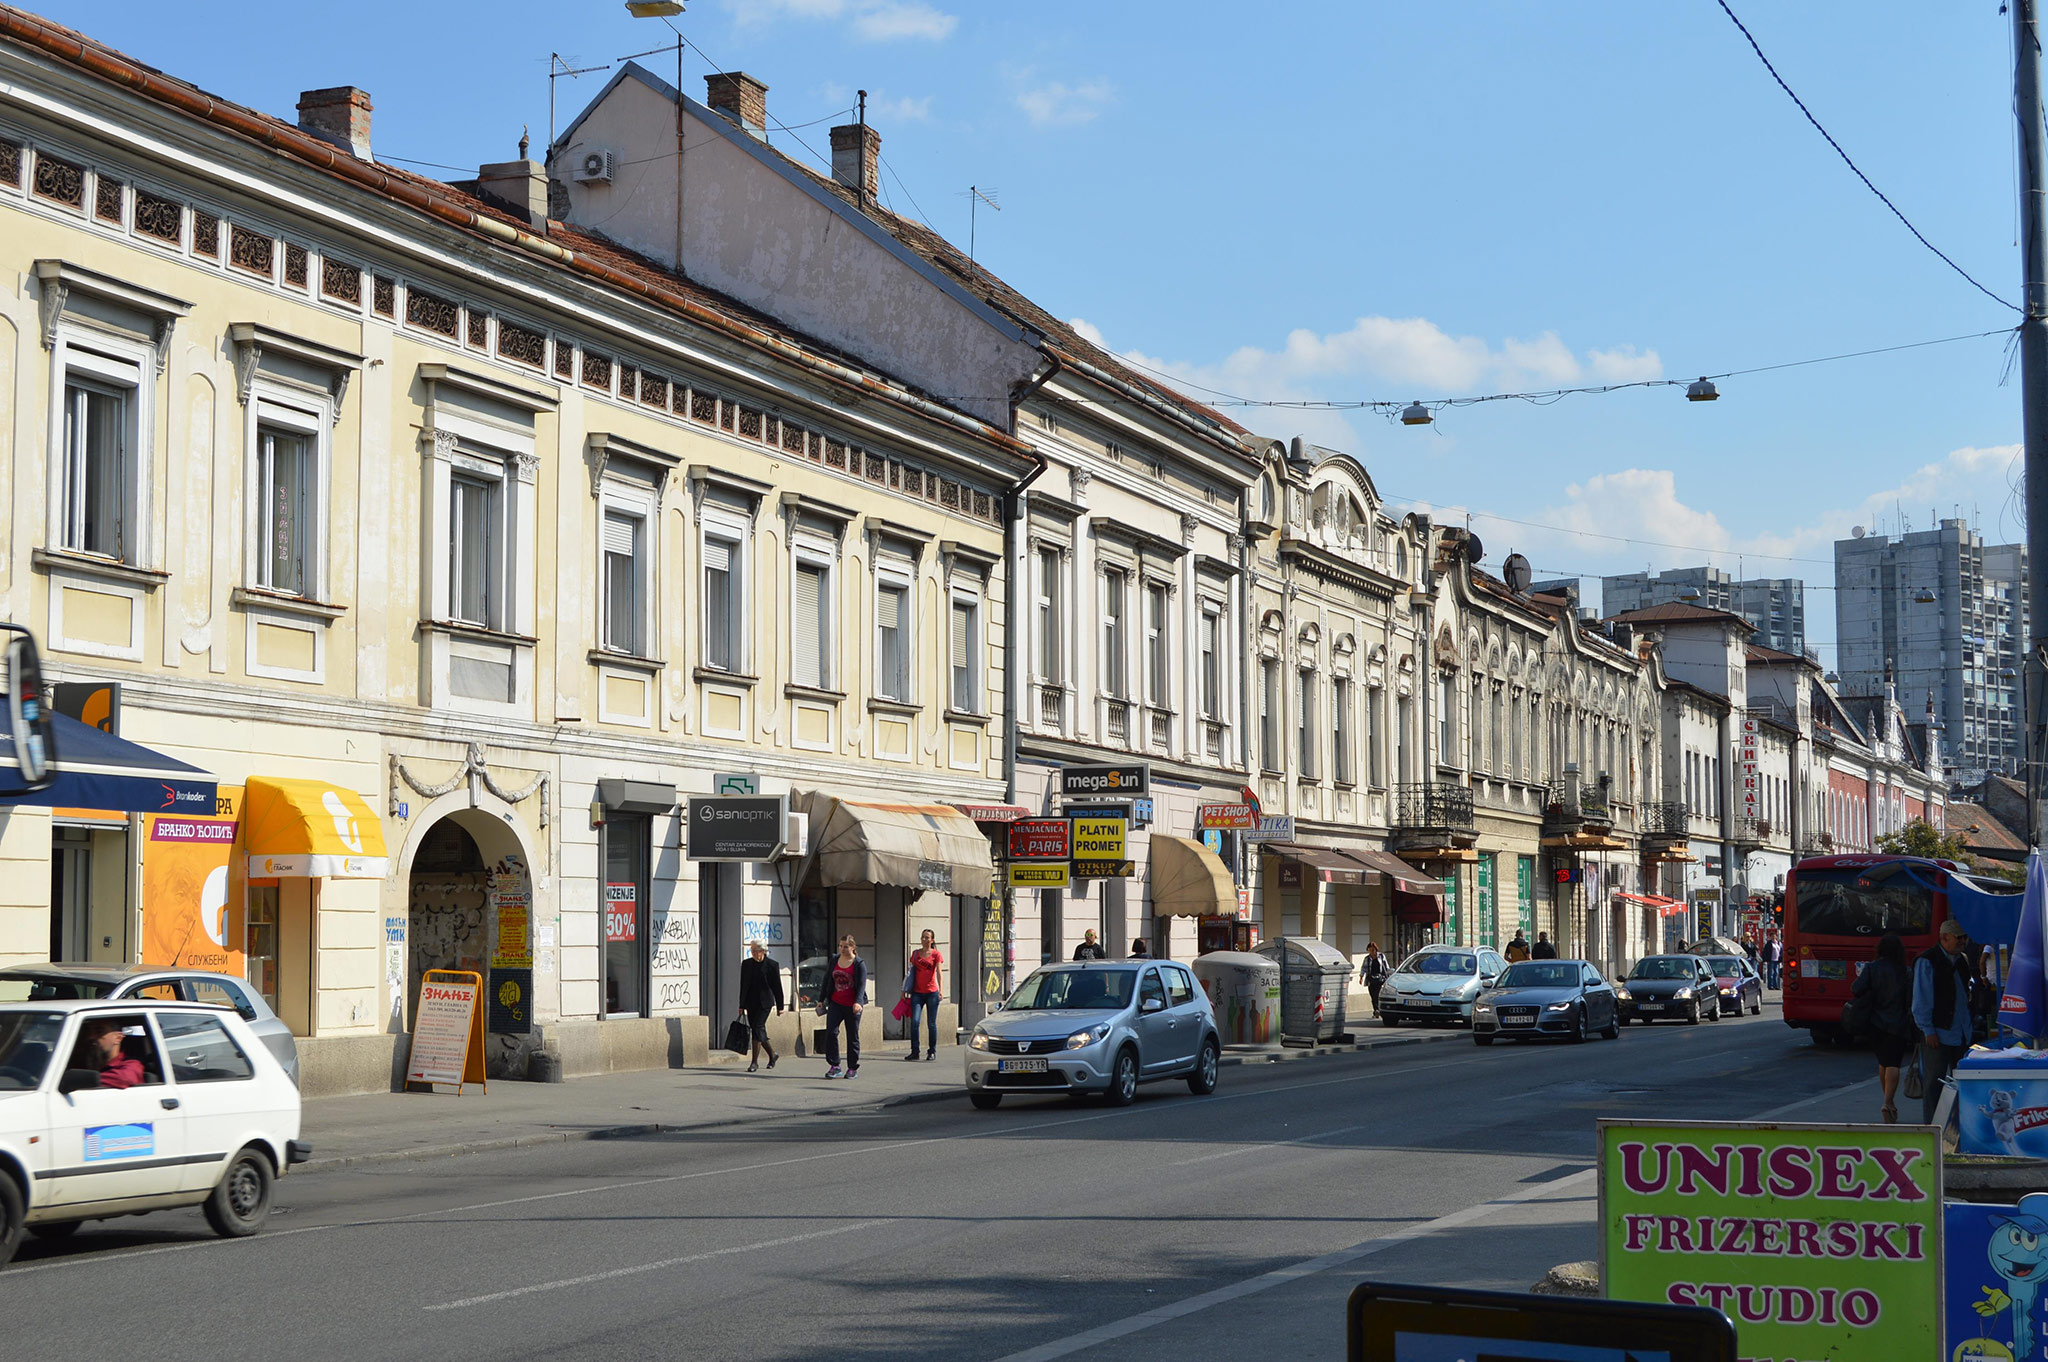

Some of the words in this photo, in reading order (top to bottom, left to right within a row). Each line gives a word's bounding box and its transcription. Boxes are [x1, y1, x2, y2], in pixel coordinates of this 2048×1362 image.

[1743, 721, 1756, 817] CENTRAL
[1067, 771, 1139, 791] megaSun
[1205, 807, 1223, 817] PET
[1224, 806, 1250, 817] SHOP
[158, 823, 195, 837] БРАНКО
[197, 825, 233, 839] ЋОПИЋ
[1014, 825, 1064, 833] MENJAČNICA
[1080, 825, 1119, 836] PLATNI
[1028, 841, 1063, 852] PARIS
[1076, 841, 1122, 851] PROMET
[607, 911, 635, 937] 50%
[188, 954, 228, 966] СЛУЖБЕНИ
[660, 981, 691, 1008] 2003
[1004, 1060, 1014, 1070] BG
[1619, 1143, 1926, 1201] UNISEX
[1624, 1214, 1926, 1261] FRIZERSKI
[1667, 1281, 1881, 1328] STUDIO
